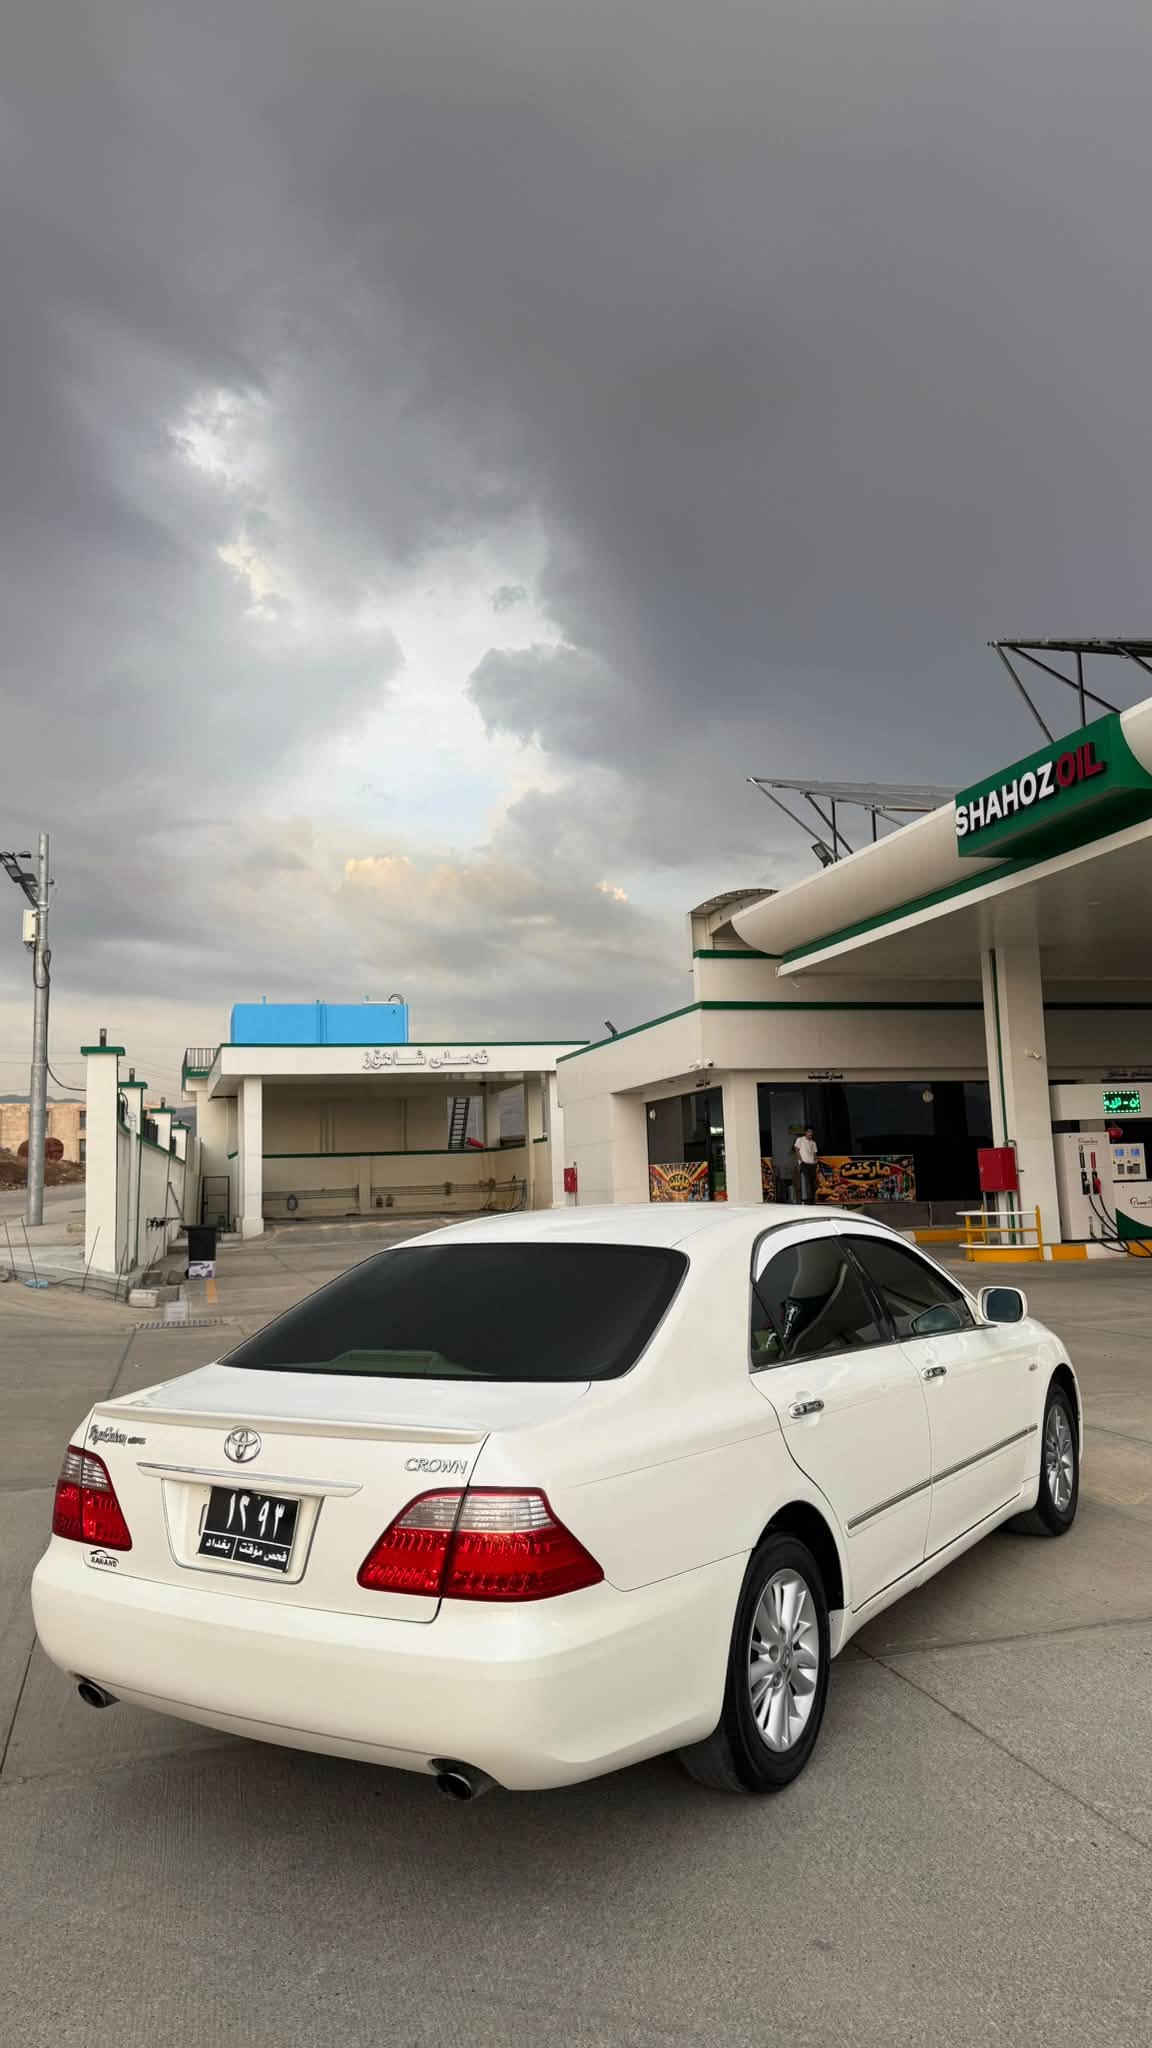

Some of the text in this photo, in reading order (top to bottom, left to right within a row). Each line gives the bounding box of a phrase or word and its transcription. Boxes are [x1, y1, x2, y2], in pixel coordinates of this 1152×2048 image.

[955, 743, 1104, 837] SHAHOZ OIL
[404, 1457, 468, 1474] CROWN
[205, 1538, 231, 1554] بغداد
